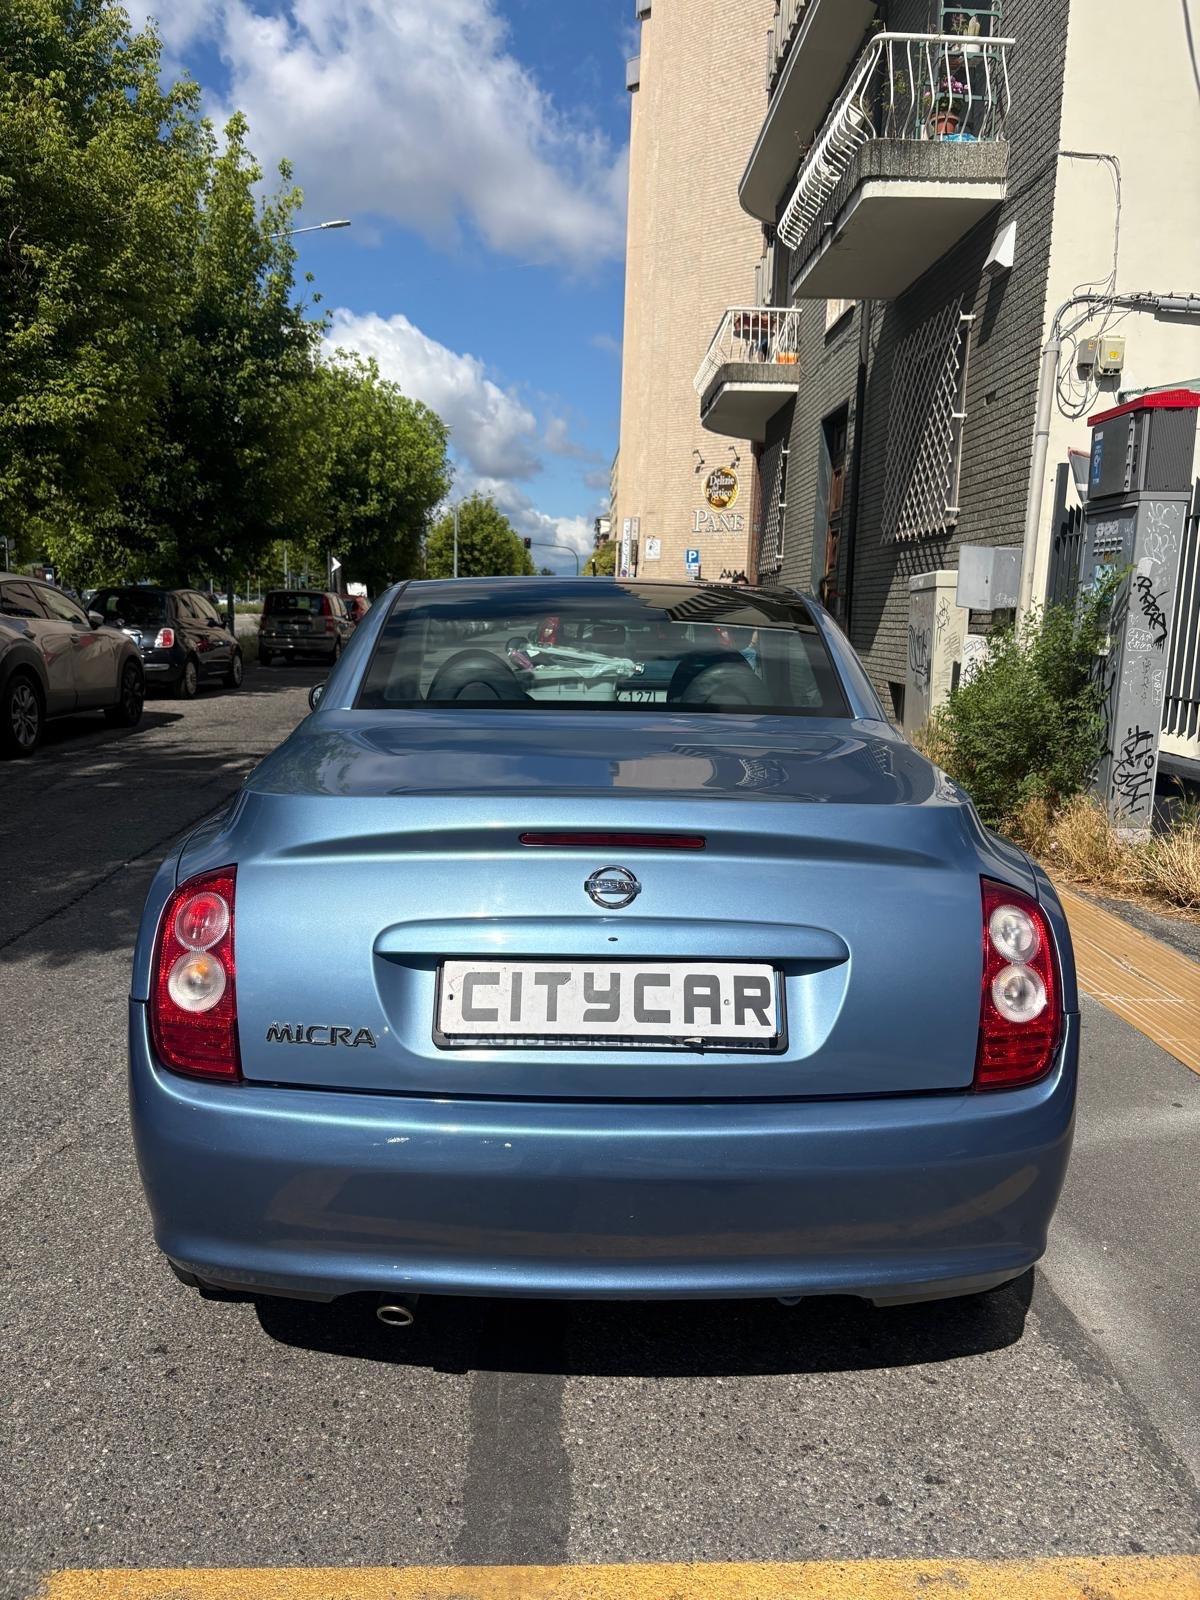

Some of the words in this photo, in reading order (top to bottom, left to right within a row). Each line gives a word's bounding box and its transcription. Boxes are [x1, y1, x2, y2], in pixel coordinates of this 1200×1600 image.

[706, 488, 732, 498] Portico
[692, 509, 745, 533] PANE
[688, 551, 697, 563] P
[590, 880, 635, 891] NISSAN
[461, 971, 772, 1027] CITYCAR
[266, 1022, 377, 1048] MICRA
